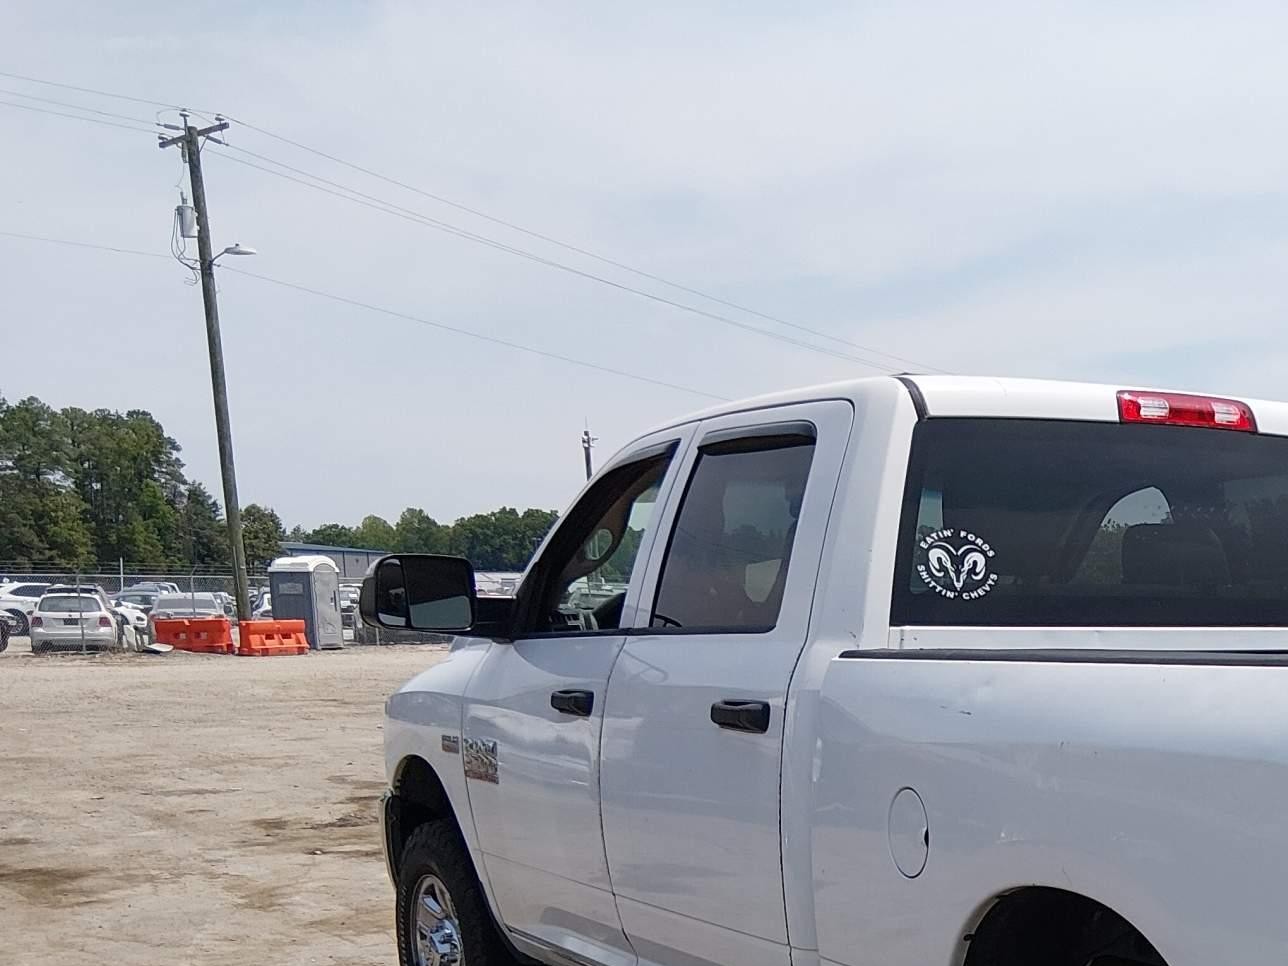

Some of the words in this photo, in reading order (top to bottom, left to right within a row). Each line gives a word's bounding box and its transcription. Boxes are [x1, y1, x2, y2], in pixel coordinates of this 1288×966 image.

[920, 528, 954, 549] EATIN'
[960, 530, 995, 557] FORDS
[917, 564, 958, 599] SHITTIN'
[962, 573, 998, 599] CHEVYS
